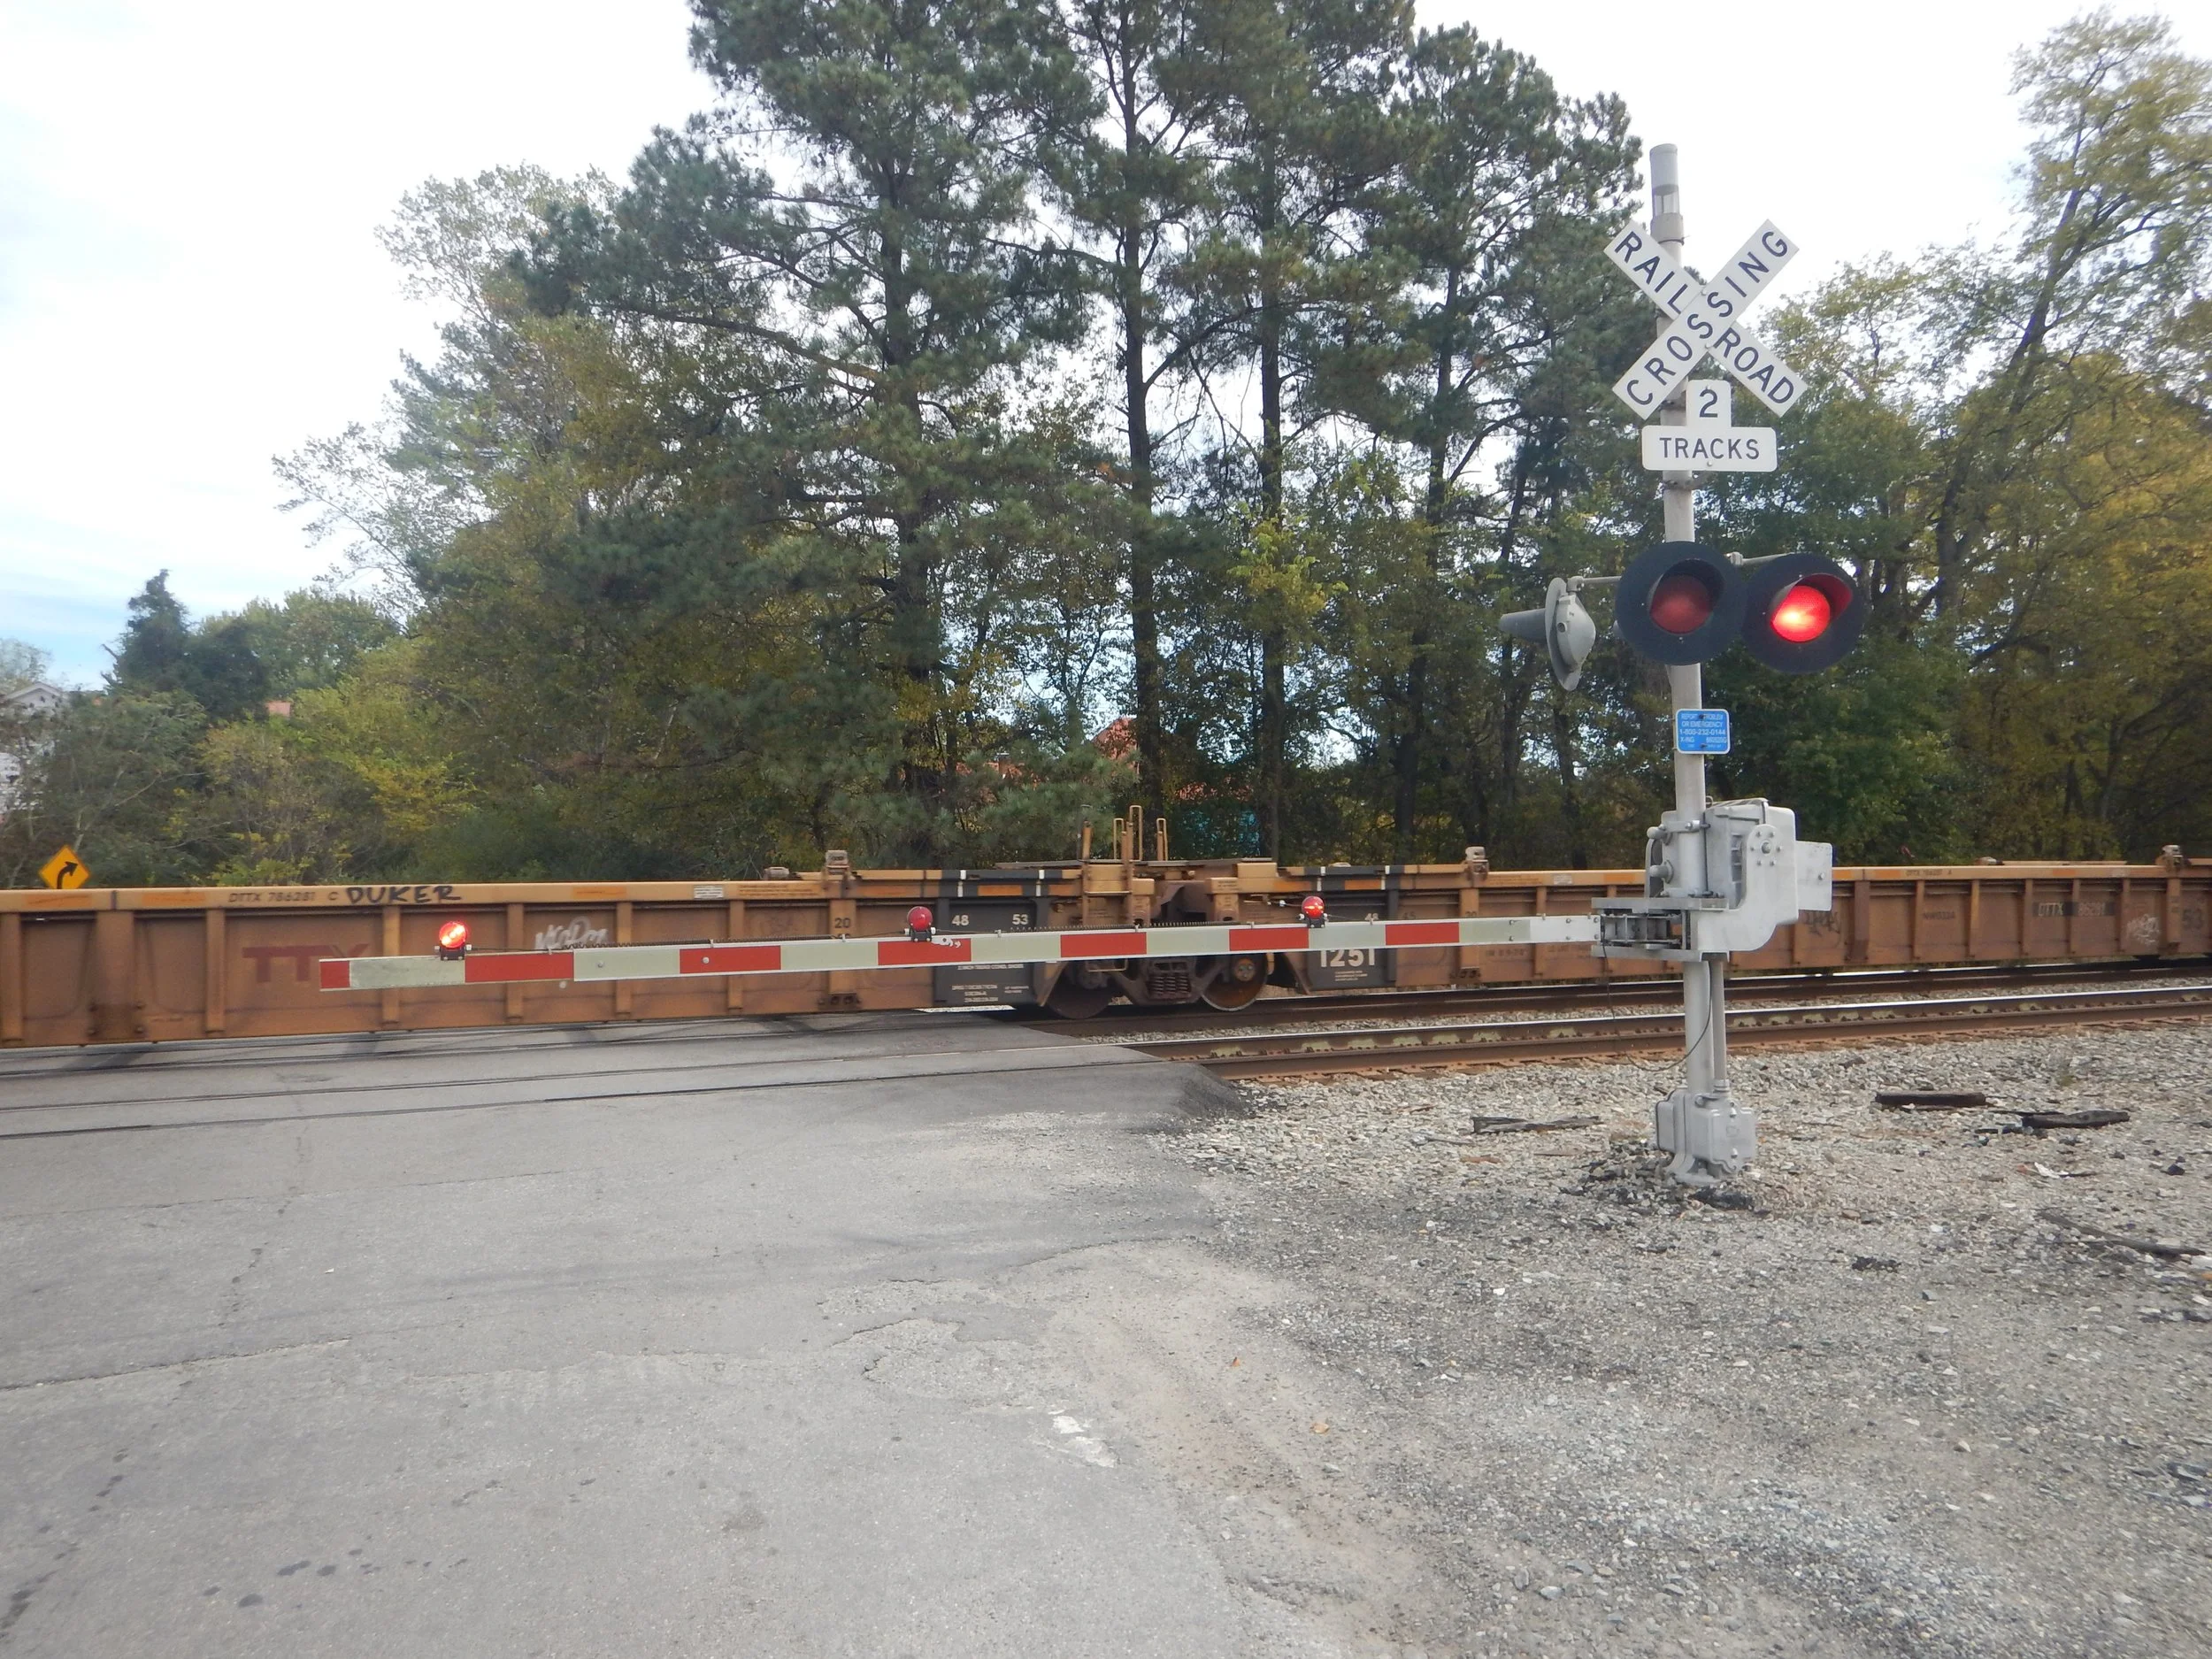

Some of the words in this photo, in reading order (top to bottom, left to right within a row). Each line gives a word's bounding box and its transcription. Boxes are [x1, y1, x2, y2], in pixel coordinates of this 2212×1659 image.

[1626, 231, 1788, 405] CROSSING
[1699, 388, 1718, 418] 2
[1659, 438, 1760, 459] TRACKS
[228, 892, 261, 902] DTTX
[344, 885, 461, 904] DUKER
[834, 918, 851, 928] 20
[951, 915, 970, 926] 48
[1011, 914, 1028, 925] 53
[1320, 949, 1375, 967] 1251
